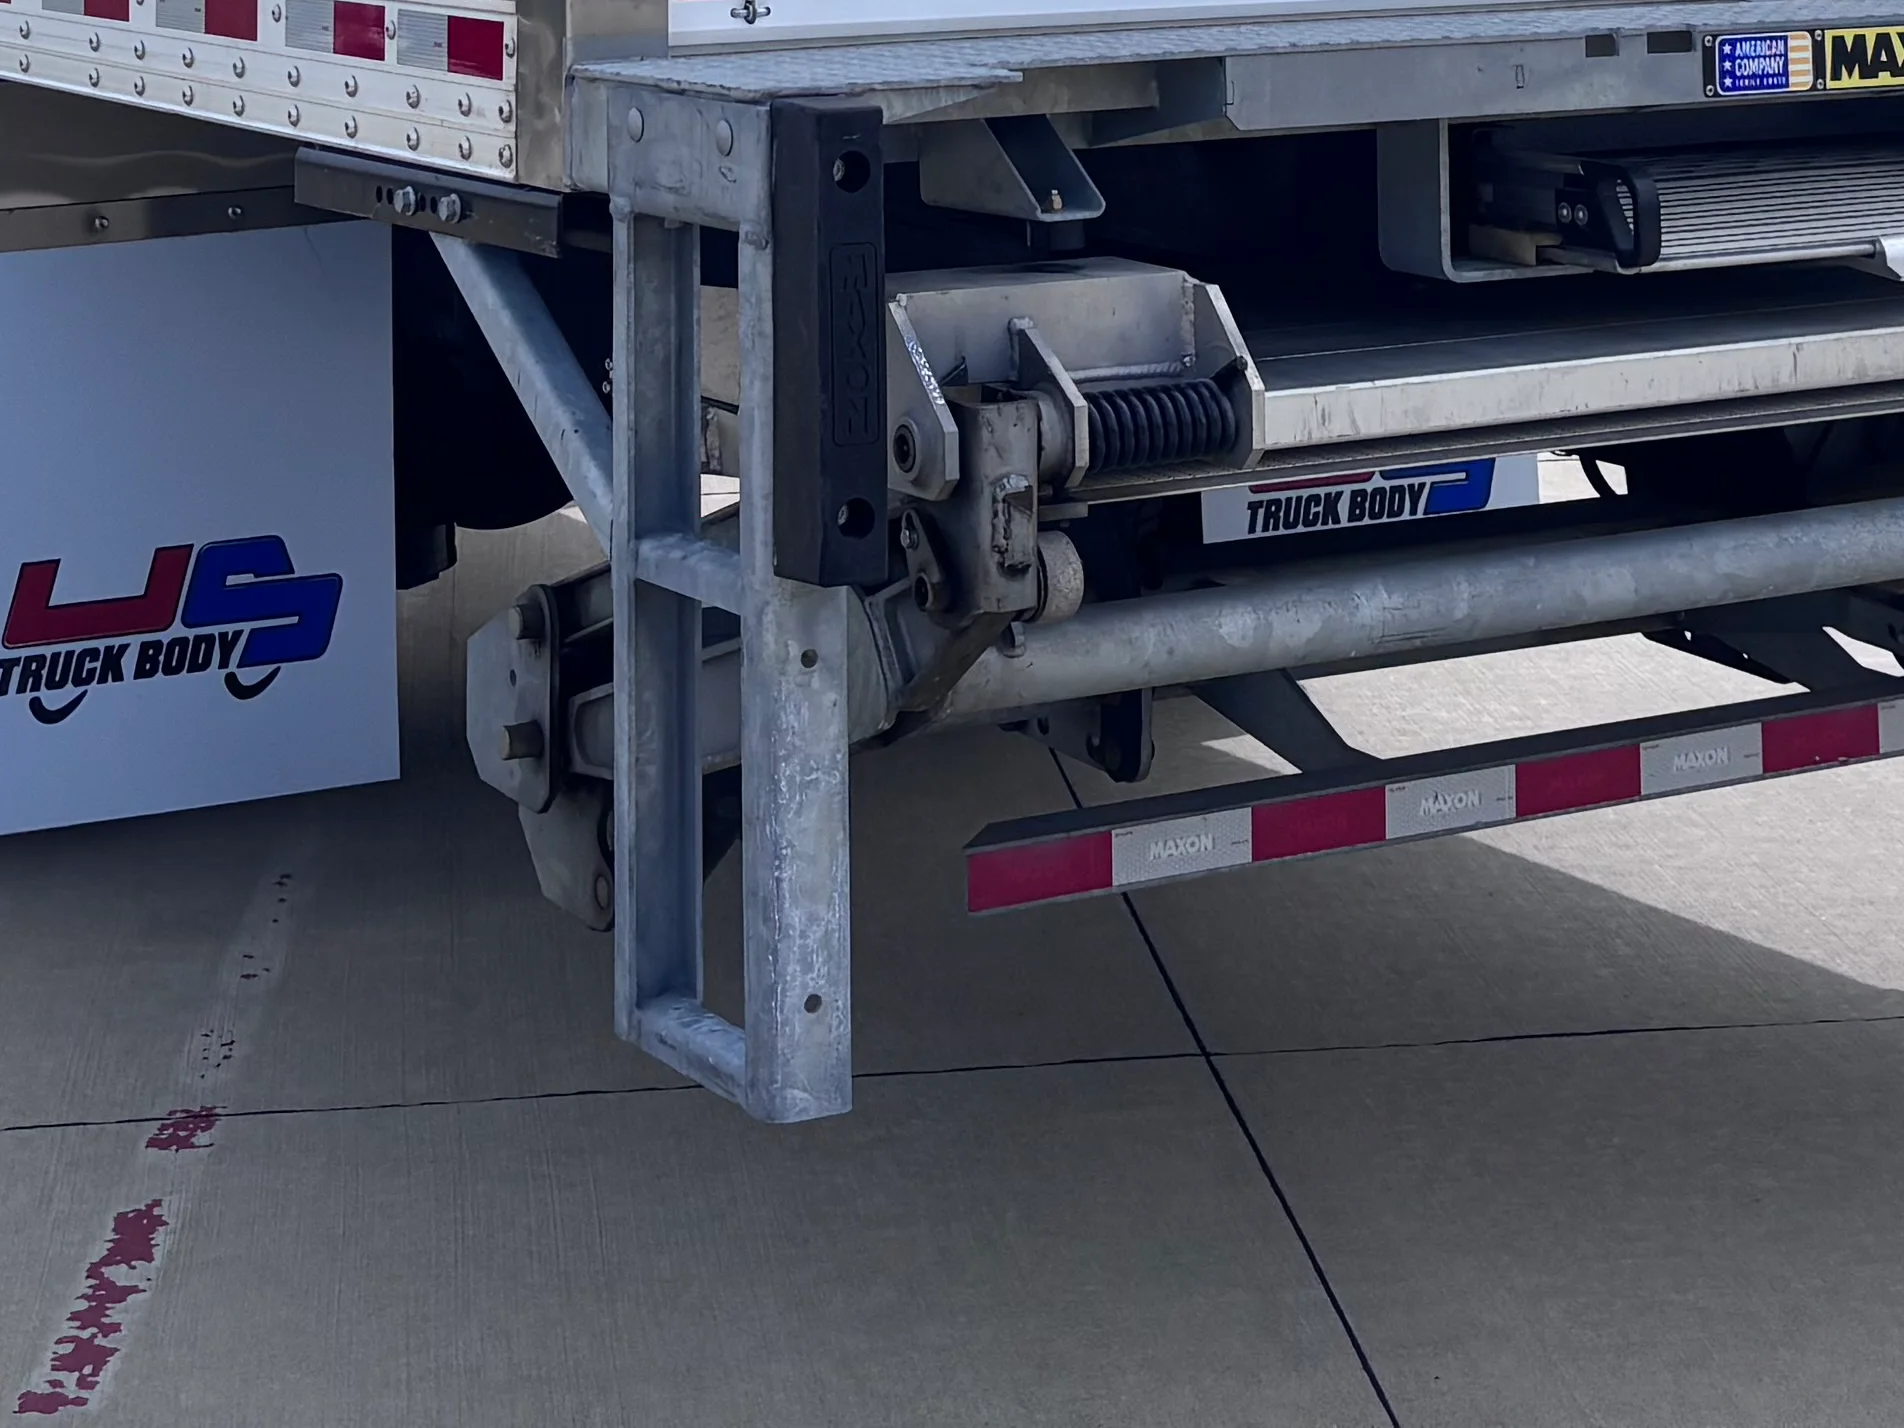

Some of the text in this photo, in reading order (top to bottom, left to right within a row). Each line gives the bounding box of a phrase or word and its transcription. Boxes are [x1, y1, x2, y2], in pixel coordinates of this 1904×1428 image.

[1735, 39, 1785, 57] AMERICAN
[1735, 56, 1785, 77] COMPANY
[1247, 481, 1428, 535] TRUCK BODY
[2, 534, 344, 670] US
[133, 629, 245, 681] BODY
[1673, 745, 1730, 773] MAXON
[1420, 789, 1482, 816] MAXON
[1150, 833, 1215, 861] MAXON
